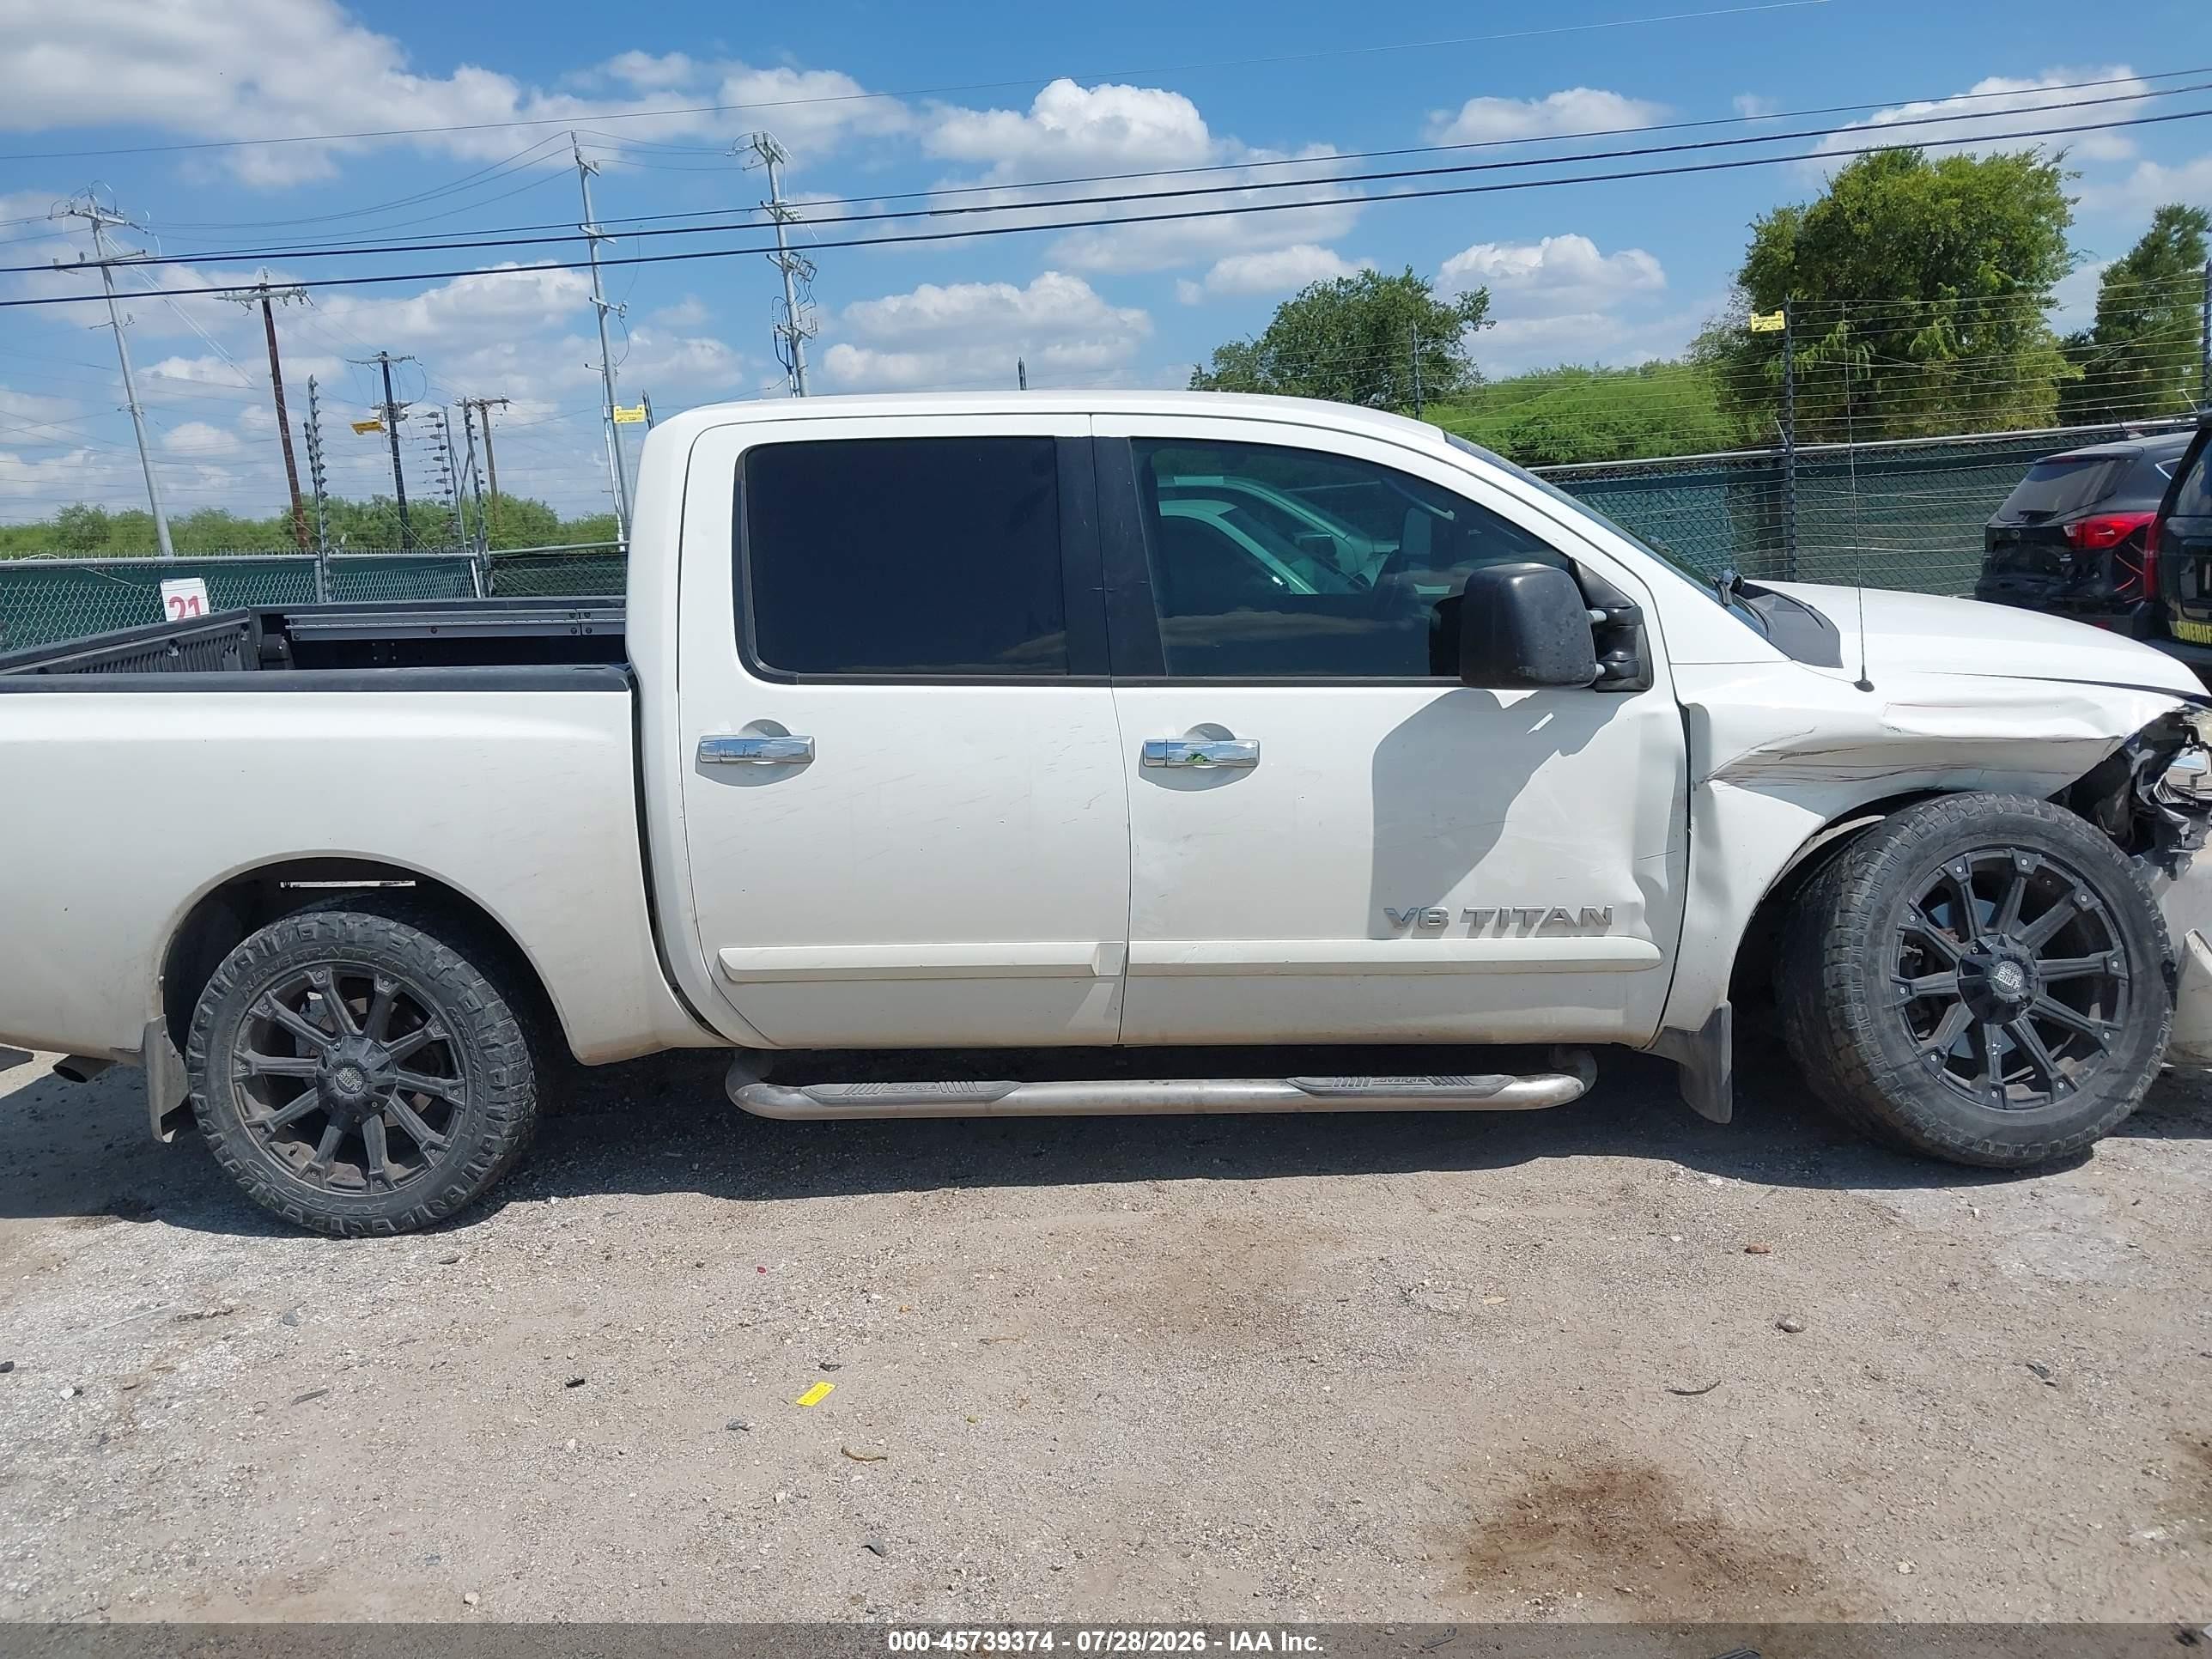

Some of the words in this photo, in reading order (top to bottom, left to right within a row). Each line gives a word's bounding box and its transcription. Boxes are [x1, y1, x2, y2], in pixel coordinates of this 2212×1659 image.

[168, 595, 201, 621] 21
[1384, 906, 1449, 930] V8
[1463, 905, 1614, 928] TITAN
